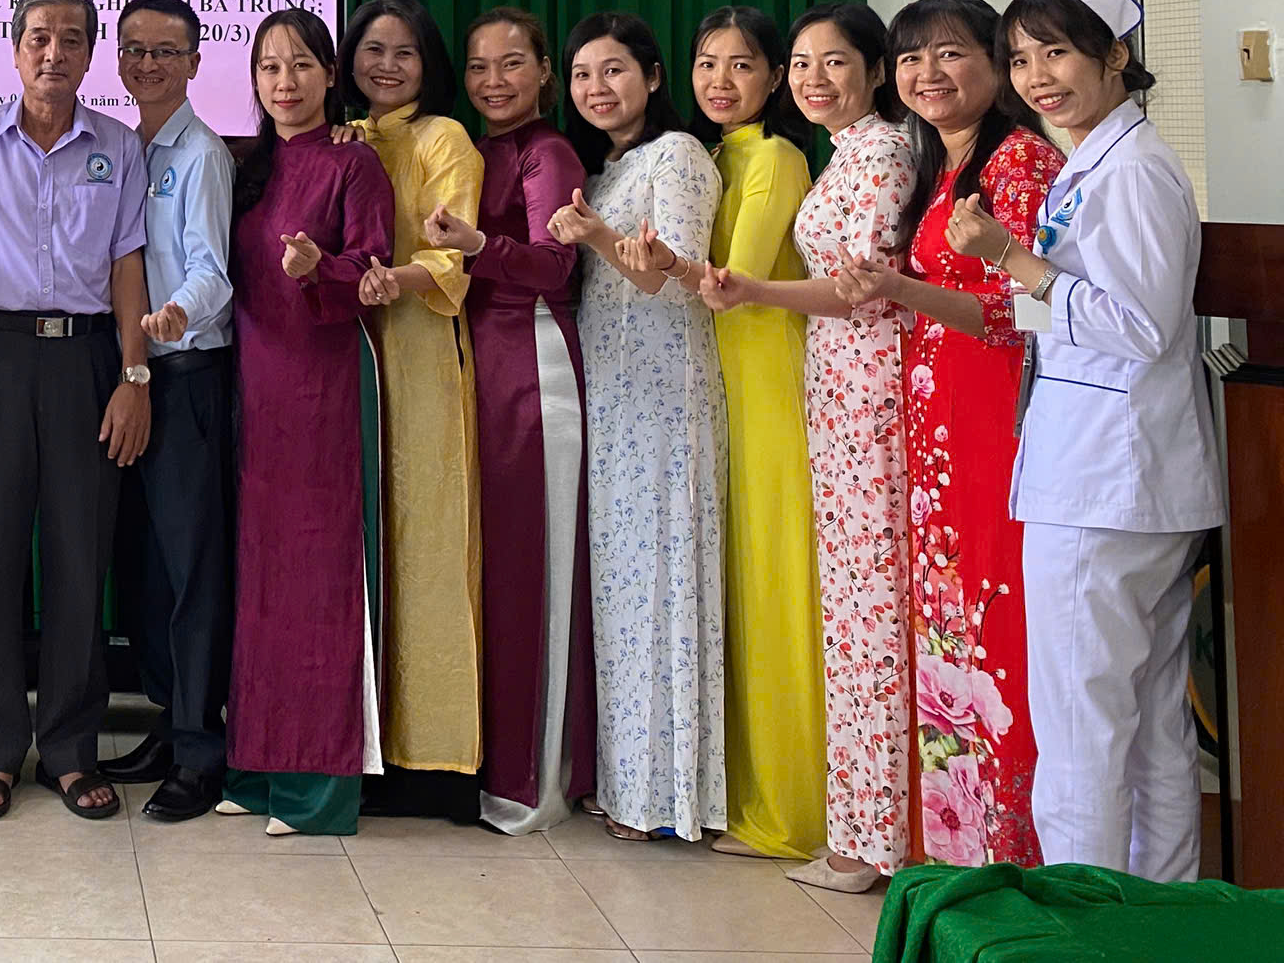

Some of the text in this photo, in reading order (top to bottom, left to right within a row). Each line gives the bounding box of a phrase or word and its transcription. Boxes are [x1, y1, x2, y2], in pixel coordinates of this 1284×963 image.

[199, 23, 251, 47] 20/3)
[90, 94, 120, 107] năm
[124, 94, 138, 107] 20
